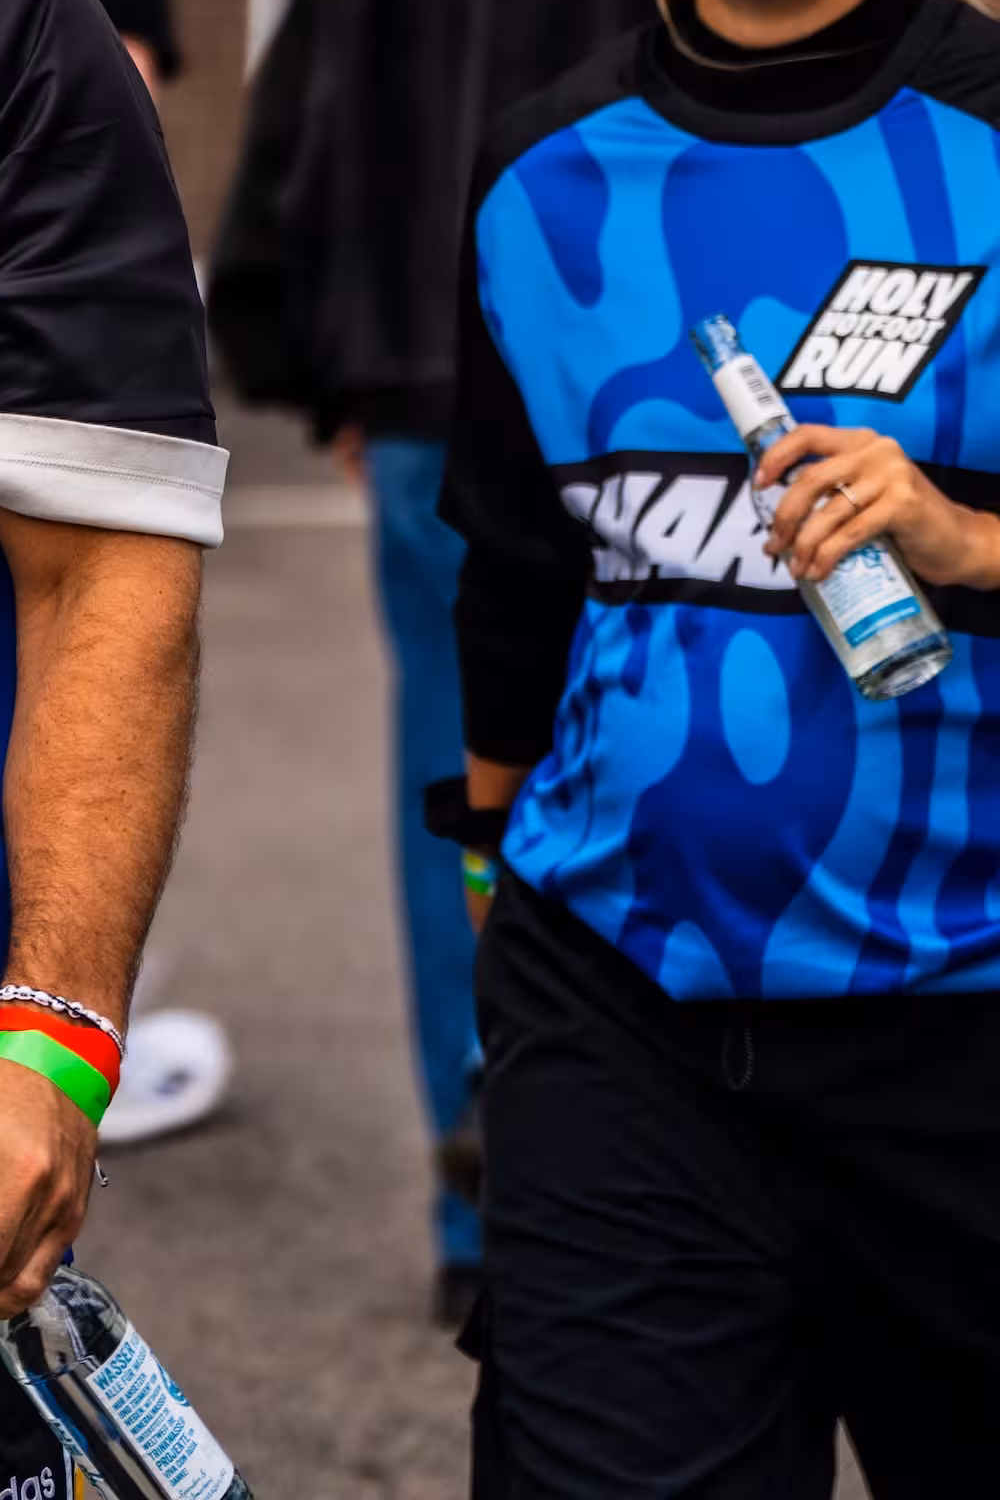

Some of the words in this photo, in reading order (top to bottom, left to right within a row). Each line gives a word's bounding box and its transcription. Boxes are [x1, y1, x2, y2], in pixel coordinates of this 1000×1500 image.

[829, 266, 975, 319] HOLY
[811, 311, 946, 345] HOTFOOT
[781, 335, 929, 394] RUN
[92, 1341, 135, 1390] WASSER
[105, 1381, 124, 1399] ALLE
[121, 1369, 135, 1385] FÜR
[112, 1397, 126, 1410] NUR
[155, 1433, 190, 1471] PROJEKTE
[163, 1465, 178, 1479] VIVA
